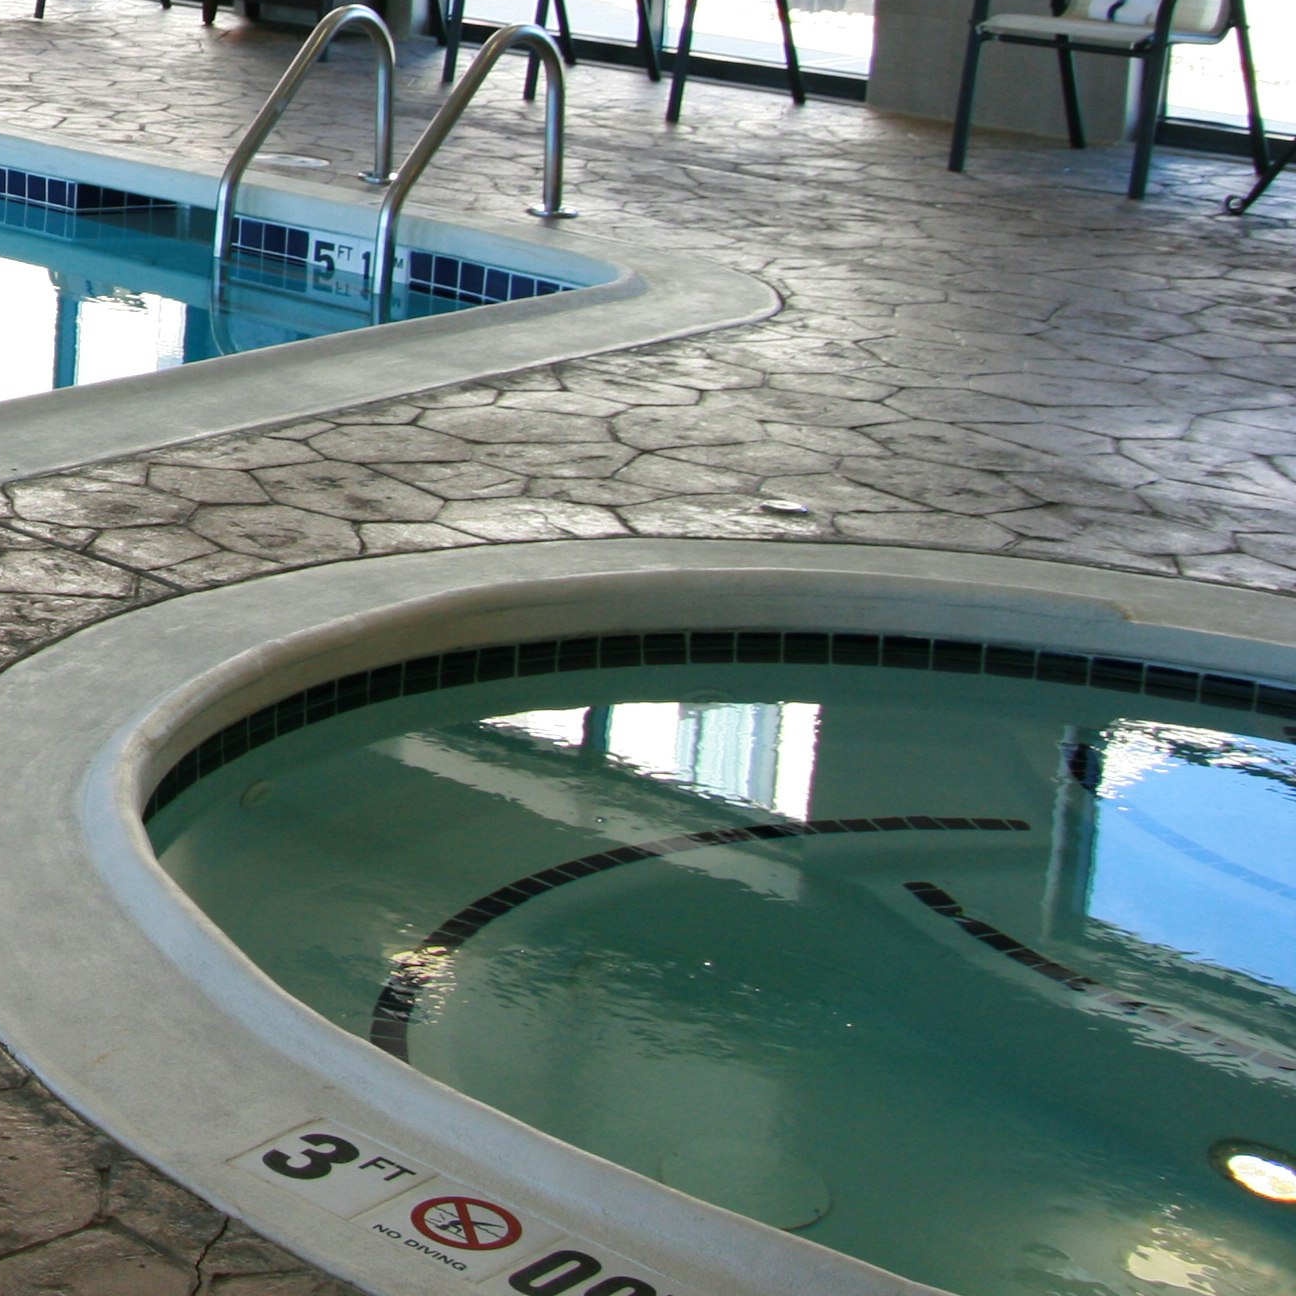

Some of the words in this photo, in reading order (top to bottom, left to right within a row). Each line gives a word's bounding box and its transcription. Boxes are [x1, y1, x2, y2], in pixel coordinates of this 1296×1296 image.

[314, 240, 335, 272] 5
[337, 245, 353, 261] FT
[262, 1133, 360, 1180] 3
[359, 1156, 416, 1182] FT
[372, 1223, 402, 1239] NO
[404, 1238, 468, 1272] DIVING
